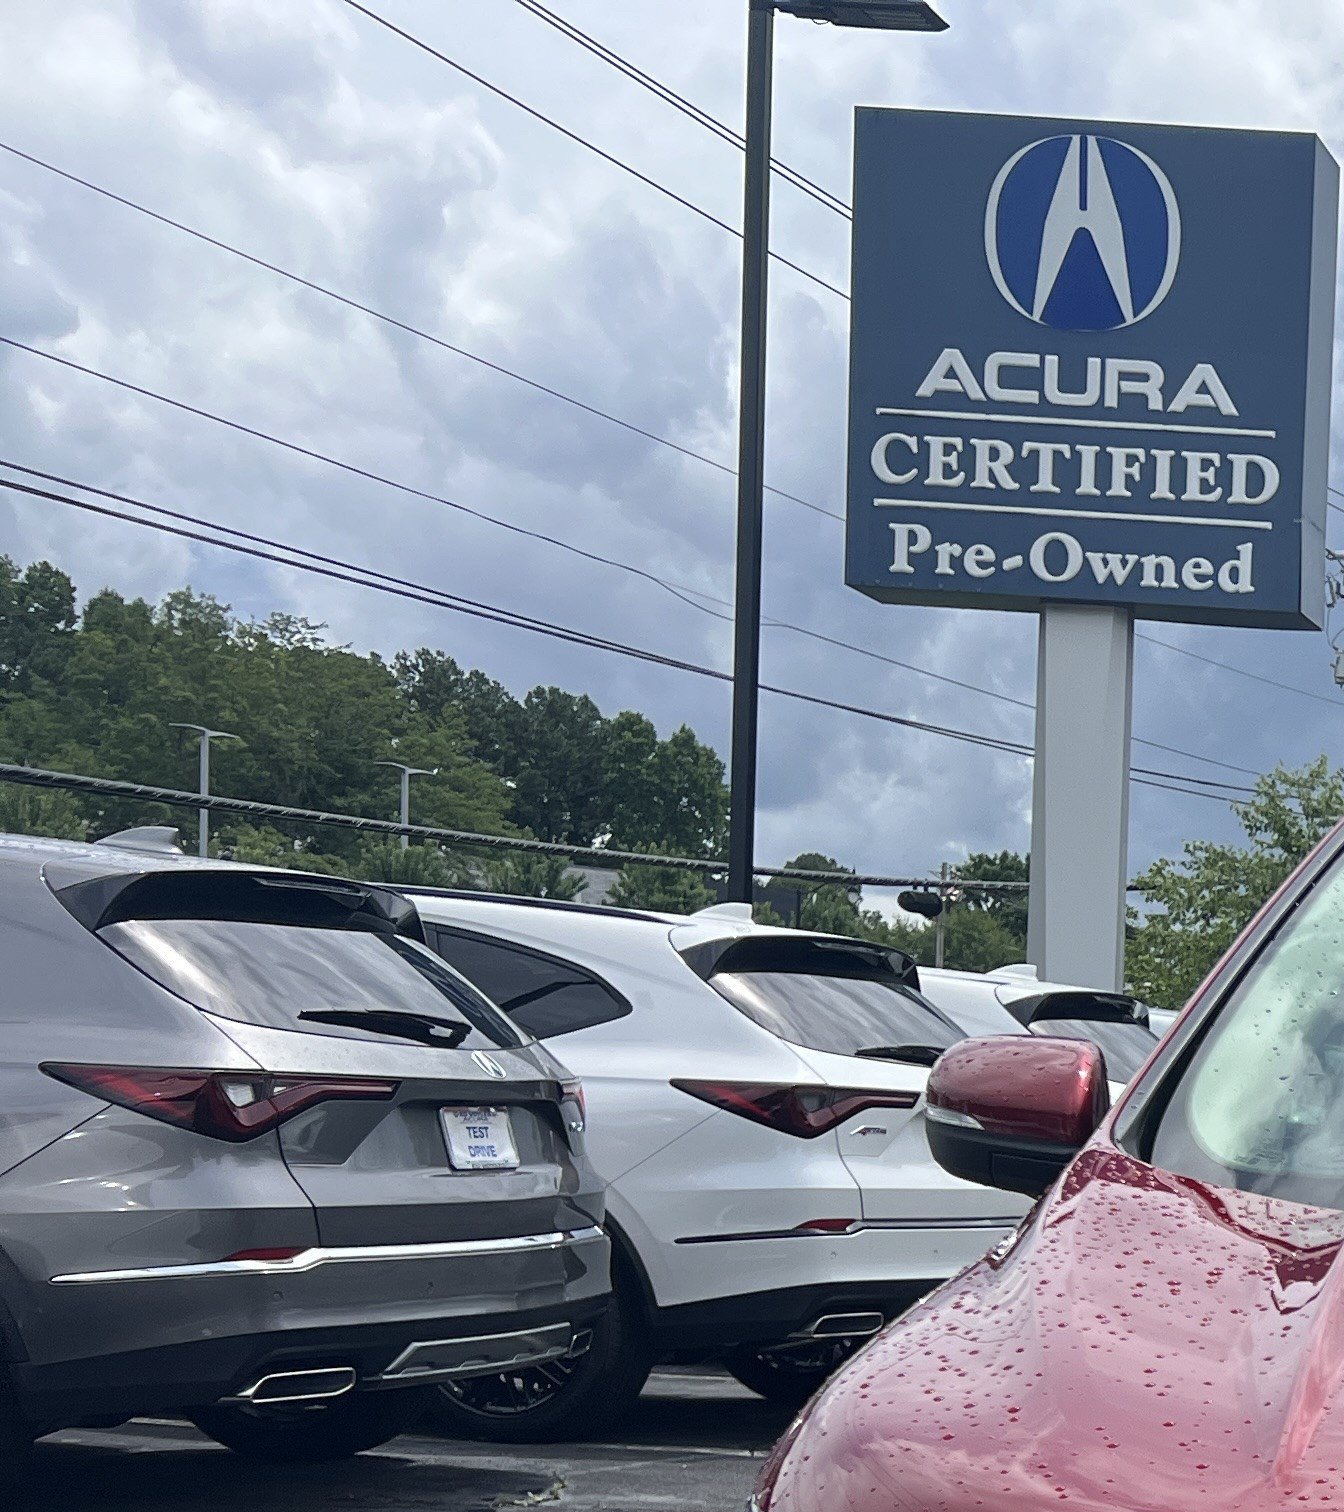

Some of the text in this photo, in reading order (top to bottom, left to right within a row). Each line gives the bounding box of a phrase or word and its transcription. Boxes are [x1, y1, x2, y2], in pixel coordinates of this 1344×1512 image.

[915, 348, 1240, 416] ACURA
[870, 432, 1280, 505] CERTIFIED
[888, 522, 1256, 594] Pre-Owned
[466, 1126, 489, 1138] TEST
[468, 1145, 497, 1157] DRIVE
